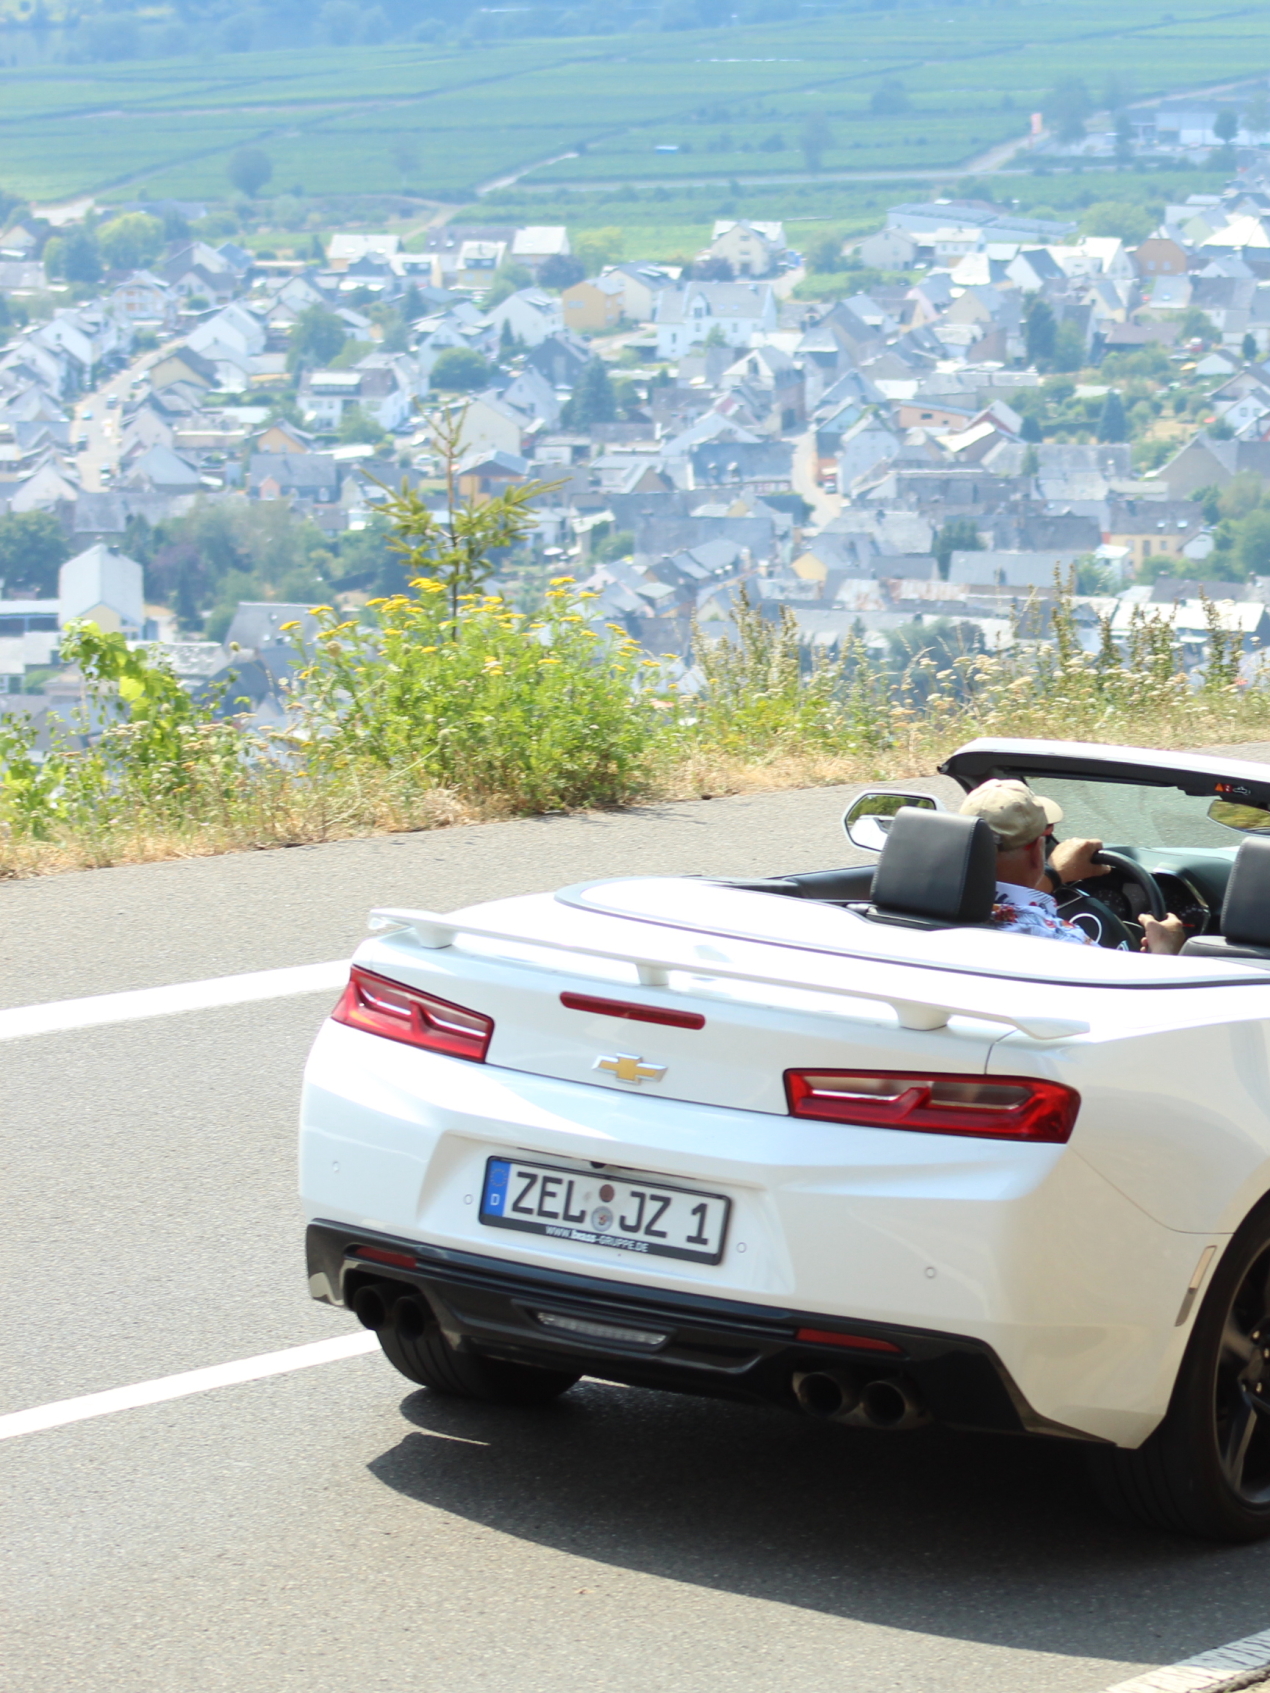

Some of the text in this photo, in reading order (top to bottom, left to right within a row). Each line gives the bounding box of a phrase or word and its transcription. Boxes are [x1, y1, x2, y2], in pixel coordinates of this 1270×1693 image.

[490, 1193, 500, 1206] D
[512, 1171, 708, 1246] ZEL JZ 1
